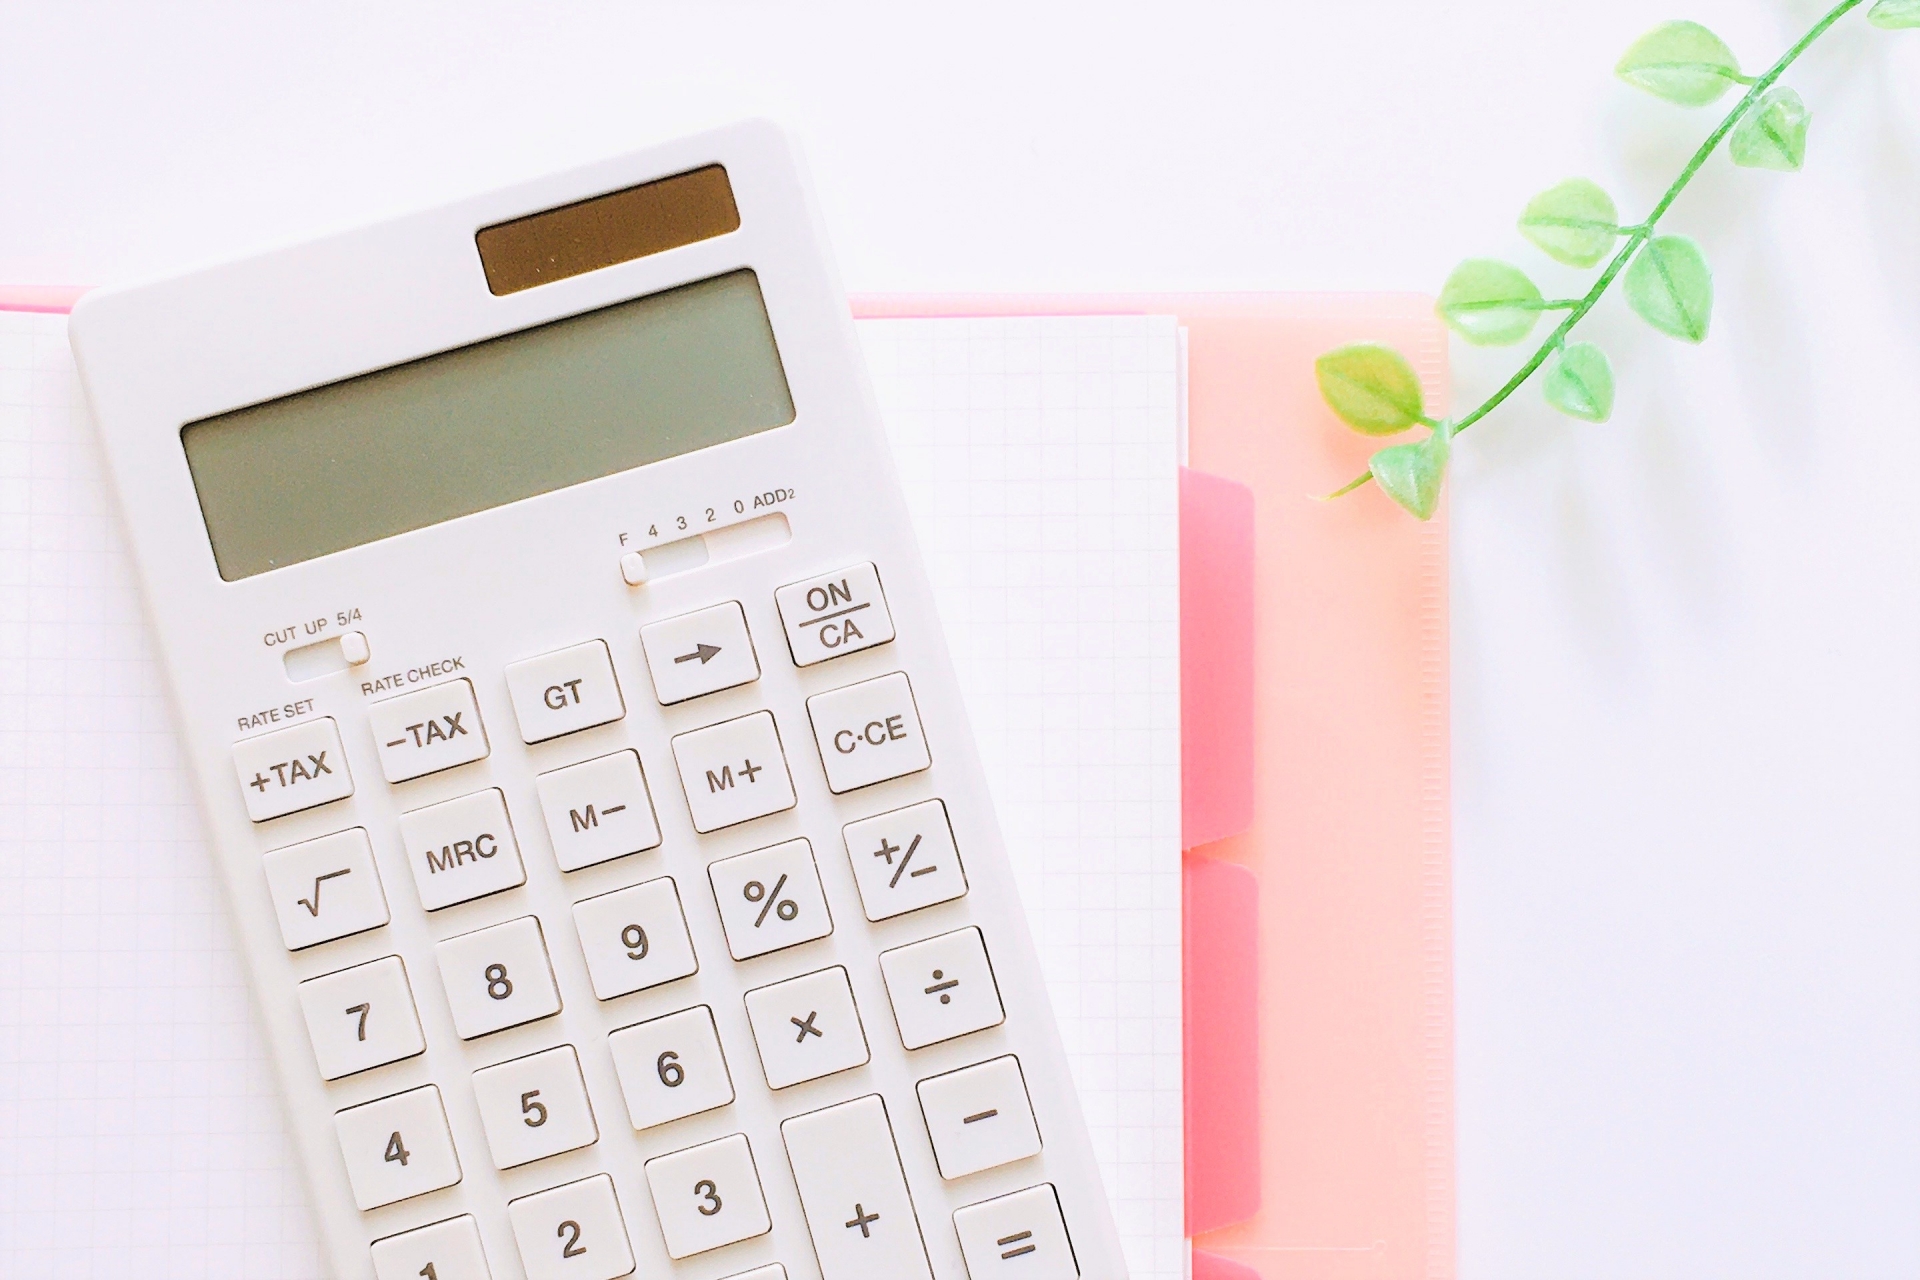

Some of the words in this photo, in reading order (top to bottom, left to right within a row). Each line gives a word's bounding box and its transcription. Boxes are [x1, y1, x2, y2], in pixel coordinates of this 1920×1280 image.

[618, 532, 628, 547] F
[648, 524, 659, 537] 4
[676, 515, 688, 531] 3
[705, 507, 717, 523] 2
[733, 499, 745, 514] 0
[806, 578, 853, 612] ON
[263, 626, 297, 648] CUT
[303, 617, 328, 635] UP
[336, 607, 363, 627] 5/4
[818, 619, 864, 649] CA
[361, 673, 405, 697] RATE
[406, 656, 466, 684] CHECK
[543, 678, 583, 711] GT
[237, 707, 281, 732] RATE
[283, 698, 315, 718] SET
[249, 750, 333, 793] +TAX
[705, 758, 763, 794] M+
[425, 833, 498, 875] MRC
[743, 873, 799, 929] %
[620, 923, 649, 961] 9
[484, 963, 513, 1001] 8
[345, 1002, 371, 1042] 7
[656, 1050, 685, 1088] 6
[520, 1089, 548, 1128] 5
[384, 1131, 411, 1167] 4
[693, 1179, 723, 1217] 3
[557, 1220, 587, 1259] 2
